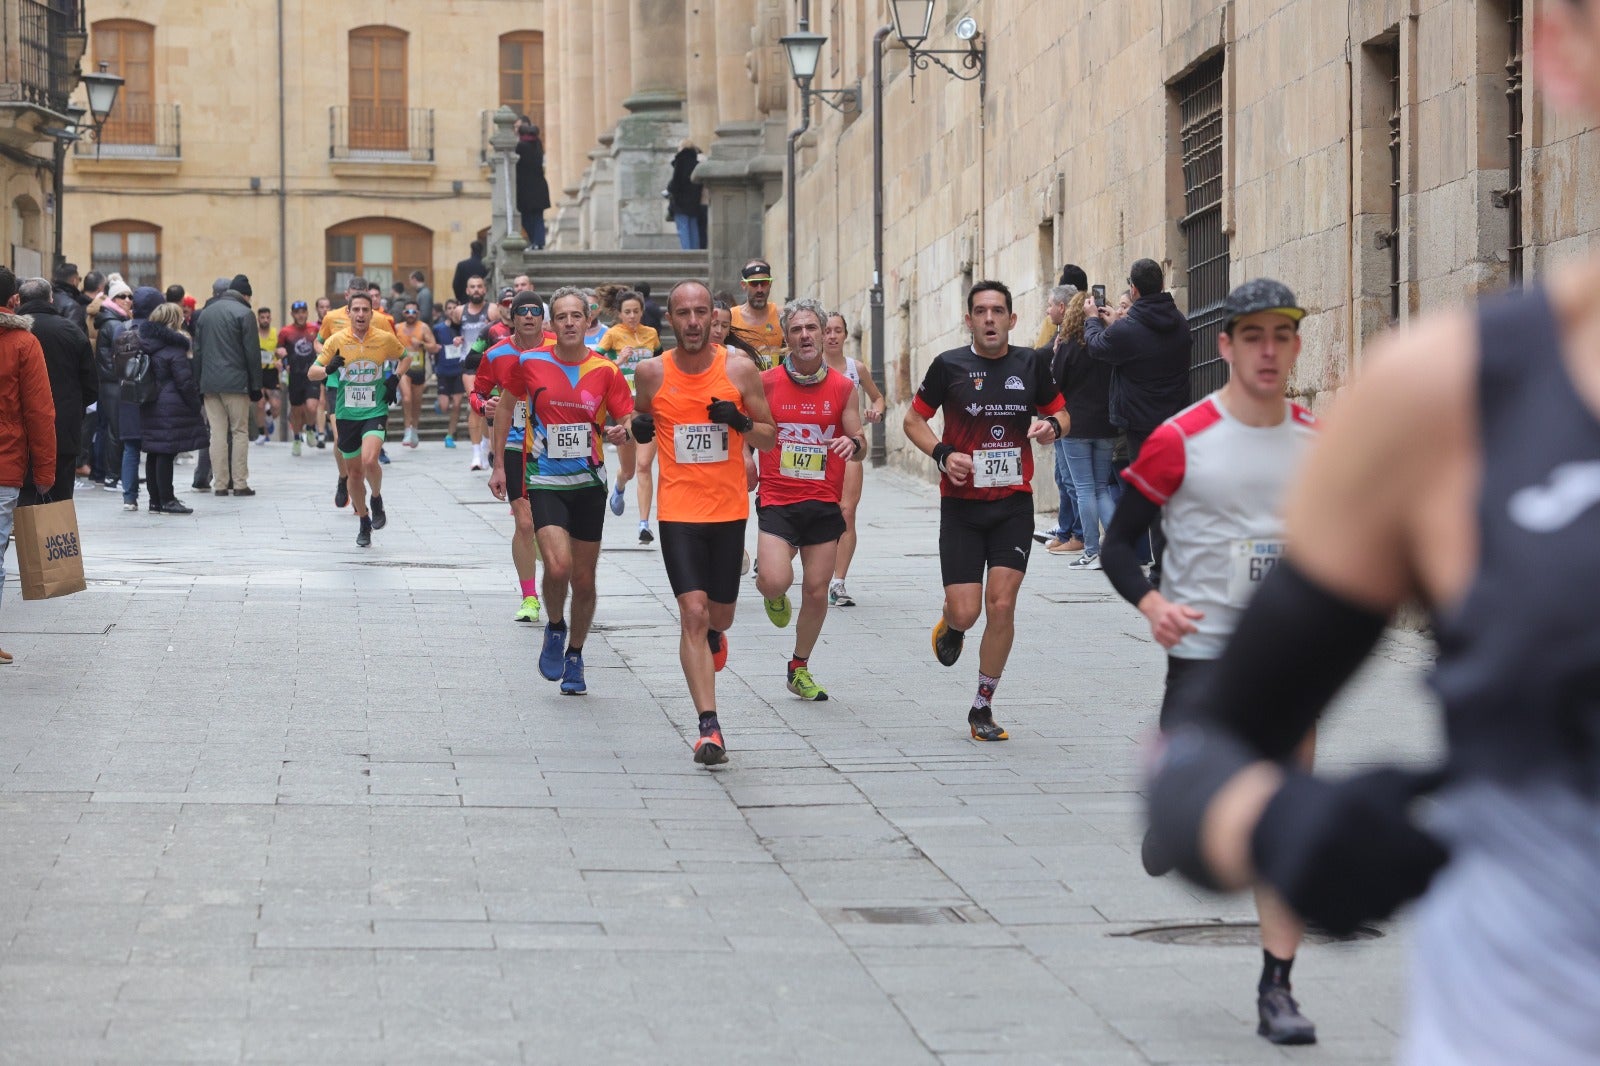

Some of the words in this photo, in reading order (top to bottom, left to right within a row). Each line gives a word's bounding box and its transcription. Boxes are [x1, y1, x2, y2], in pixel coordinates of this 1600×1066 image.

[351, 391, 366, 401] 404
[1004, 404, 1028, 412] RURAL
[688, 425, 723, 433] SETEL
[557, 433, 580, 447] 654
[686, 434, 712, 450] 276
[793, 453, 812, 468] 147
[987, 450, 1018, 459] SETEL
[985, 459, 1009, 475] 374
[47, 544, 79, 562] JONES
